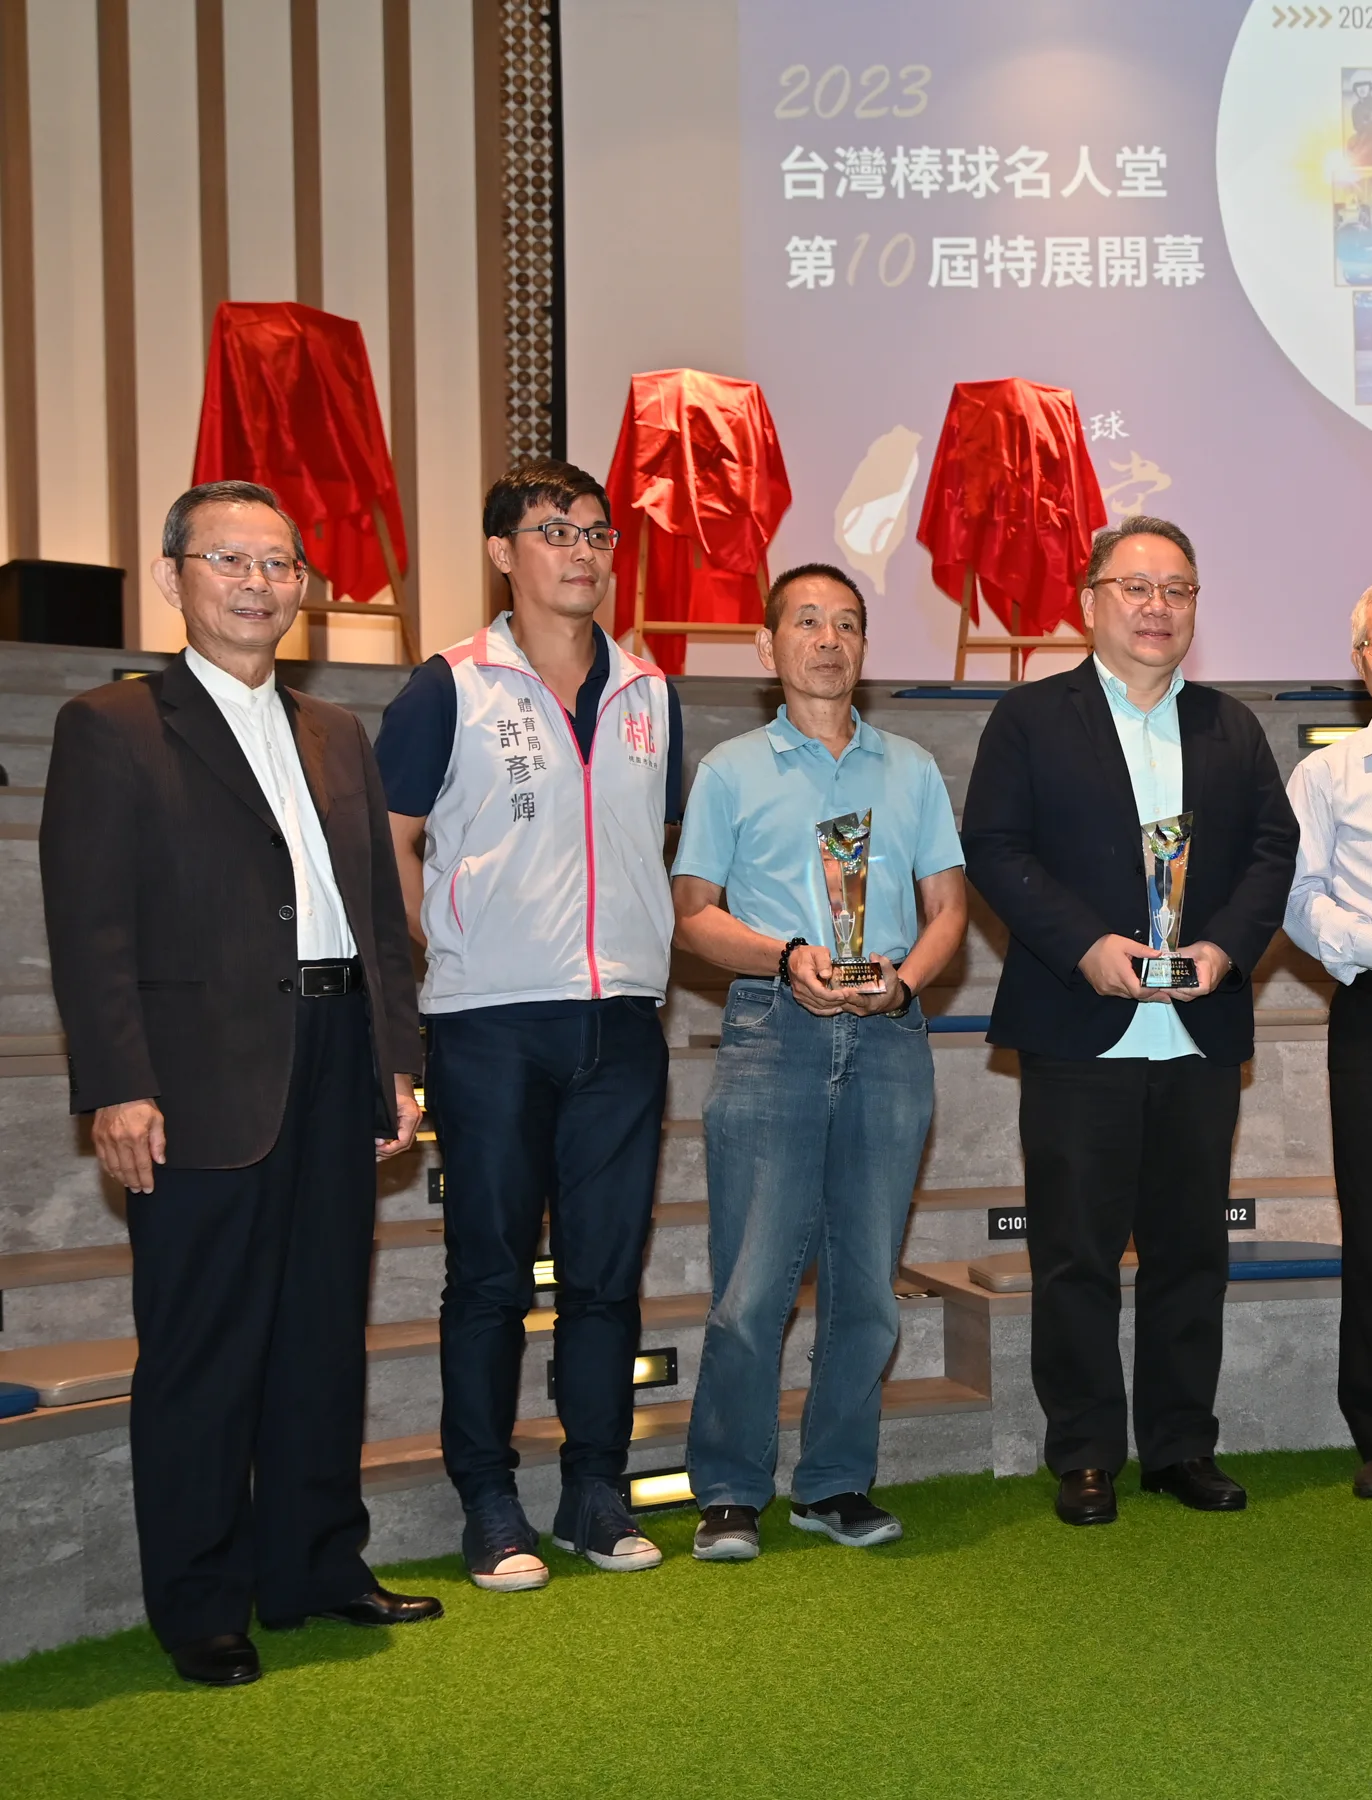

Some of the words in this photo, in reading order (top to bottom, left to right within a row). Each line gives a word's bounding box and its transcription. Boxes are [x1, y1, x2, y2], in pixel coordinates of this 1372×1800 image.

[774, 64, 932, 119] 2023
[780, 145, 1168, 200] 台灣棒球名人堂
[785, 232, 1206, 290] 第10屆特展開幕
[1082, 409, 1130, 441] 球
[517, 697, 546, 771] 體育局長
[497, 719, 536, 822] 許彥輝
[997, 1217, 1027, 1230] C101
